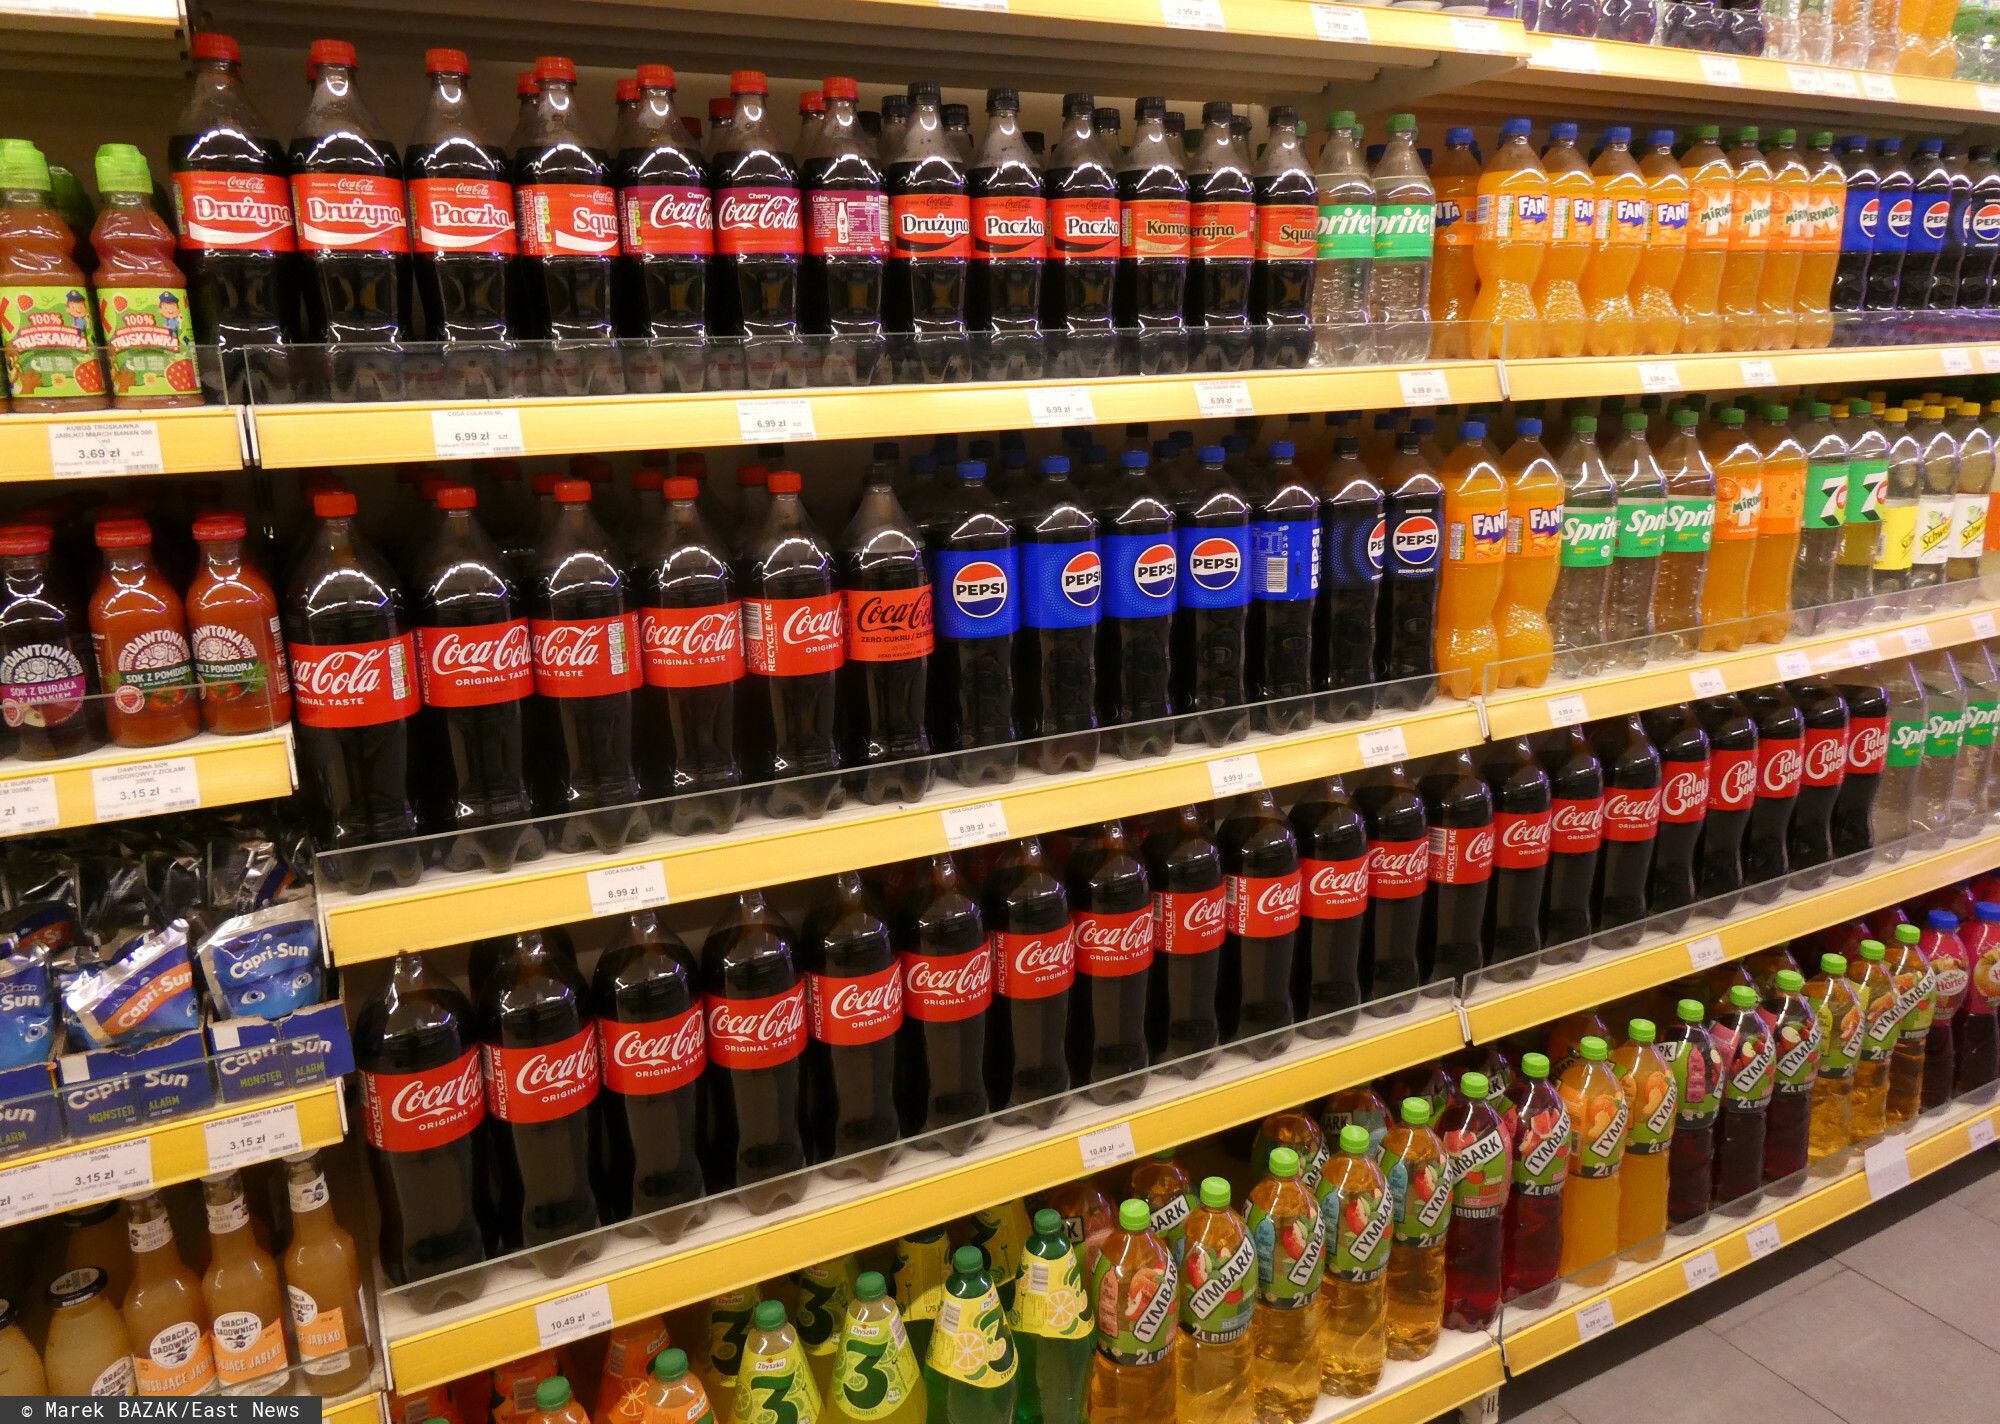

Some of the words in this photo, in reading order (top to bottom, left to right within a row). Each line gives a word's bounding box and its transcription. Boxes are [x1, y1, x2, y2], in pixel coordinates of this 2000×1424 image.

[306, 197, 402, 228] Drużyna
[431, 201, 512, 227] Paczka
[718, 195, 799, 230] Coca-Cola
[902, 214, 969, 237] Drużyna
[985, 216, 1044, 236] Paczka
[1066, 216, 1119, 236] Paczka
[29, 312, 62, 326] 100%
[125, 314, 155, 326] 100%
[13, 332, 88, 350] TRUSKAWKA
[111, 332, 179, 349] TRUSKAWKA
[757, 419, 776, 428] 6.99
[778, 418, 787, 427] zł
[455, 432, 477, 442] 6.99
[481, 431, 489, 441] zł
[78, 449, 105, 459] 3.69
[110, 448, 120, 458] zł
[1396, 534, 1437, 547] PEPSI
[1193, 557, 1239, 570] PEPSI
[1311, 528, 1320, 590] PEPSI
[1138, 564, 1175, 578] PEPSI
[956, 582, 1005, 596] PEPSI
[767, 604, 773, 622] ME
[126, 630, 184, 653] DAWTONA
[642, 611, 737, 655] Coca-Cola
[861, 635, 882, 643] ZERO
[883, 634, 911, 643] CUKRU
[4, 643, 71, 667] DAWTONA
[652, 656, 695, 666] ORIGINAL
[698, 654, 726, 664] TASTE
[767, 630, 776, 672] RECYCLE
[210, 661, 254, 673] POMIDORA
[553, 669, 584, 678] TASTE
[126, 673, 144, 684] SOK
[147, 673, 153, 683] Z
[455, 674, 505, 687] ORIGINAL
[10, 686, 28, 697] SOK
[37, 681, 77, 695] BURAKA
[328, 697, 364, 706] TASTE
[102, 771, 151, 783] POMIDOROWY
[119, 788, 146, 801] 3.15
[150, 786, 160, 797] zł
[5, 805, 16, 816] zł
[960, 824, 976, 834] 8.99
[978, 822, 984, 831] zł
[1446, 845, 1454, 883] RECYCLE
[1450, 830, 1457, 844] ME
[608, 888, 628, 899] 8.99
[631, 886, 638, 896] zł
[1239, 878, 1247, 894] ME
[1165, 894, 1173, 911] ME
[1326, 896, 1359, 905] ORIGINAL
[1238, 896, 1246, 935] RECYCLE
[1165, 912, 1173, 951] RECYCLE
[229, 942, 309, 980] Capri-Sun
[1089, 953, 1129, 962] ORIGINAL
[1034, 967, 1069, 983] ORIGINAL
[1936, 976, 1966, 992] Hortex
[2, 992, 41, 1012] Sun
[118, 971, 192, 1028] Capri-Sun
[923, 997, 966, 1006] ORIGINAL
[814, 998, 822, 1039] RECYCLE
[851, 1013, 889, 1029] ORIGINAL
[724, 1043, 769, 1053] ORIGINAL
[772, 1034, 798, 1049] TASTE
[220, 1037, 279, 1076] Capri
[291, 1038, 332, 1056] Sun
[494, 1047, 502, 1067] ME
[240, 1070, 283, 1088] MONSTER
[295, 1061, 326, 1077] ALARM
[635, 1062, 682, 1079] ORIGINAL
[67, 1071, 131, 1111] Capri
[144, 1070, 190, 1089] Sun
[367, 1073, 378, 1090] ME
[494, 1069, 508, 1120] RECYCLE
[541, 1081, 587, 1104] ORIGINAL
[88, 1105, 136, 1125] MONSTER
[148, 1095, 180, 1112] ALARM
[205, 1117, 239, 1130] CAPRI-SUN
[241, 1109, 271, 1122] MONSTER
[273, 1104, 295, 1115] ALARM
[367, 1092, 383, 1148] RECYCLE
[419, 1112, 466, 1132] ORIGINAL
[89, 1144, 122, 1156] MONSTER
[124, 1138, 147, 1149] ALARM
[229, 1137, 253, 1151] 3.15
[257, 1133, 266, 1145] zł
[1090, 1145, 1107, 1157] 10.49
[1108, 1143, 1114, 1152] zł
[75, 1172, 101, 1187] 3.15
[104, 1169, 114, 1181] zł
[1192, 1240, 1254, 1313] TYMBARK
[215, 1321, 260, 1337] SADOWNICY
[221, 1316, 249, 1328] BRACIA
[552, 1315, 576, 1331] 10.49
[578, 1312, 586, 1323] zł
[160, 1327, 190, 1345] BRACIA
[852, 1326, 879, 1336] Zbyszko
[152, 1331, 199, 1355] SADOWNICY
[103, 1362, 128, 1385] BRACIA
[757, 1361, 785, 1371] Zbyszko
[842, 1339, 889, 1410] 3
[750, 1371, 799, 1424] 3
